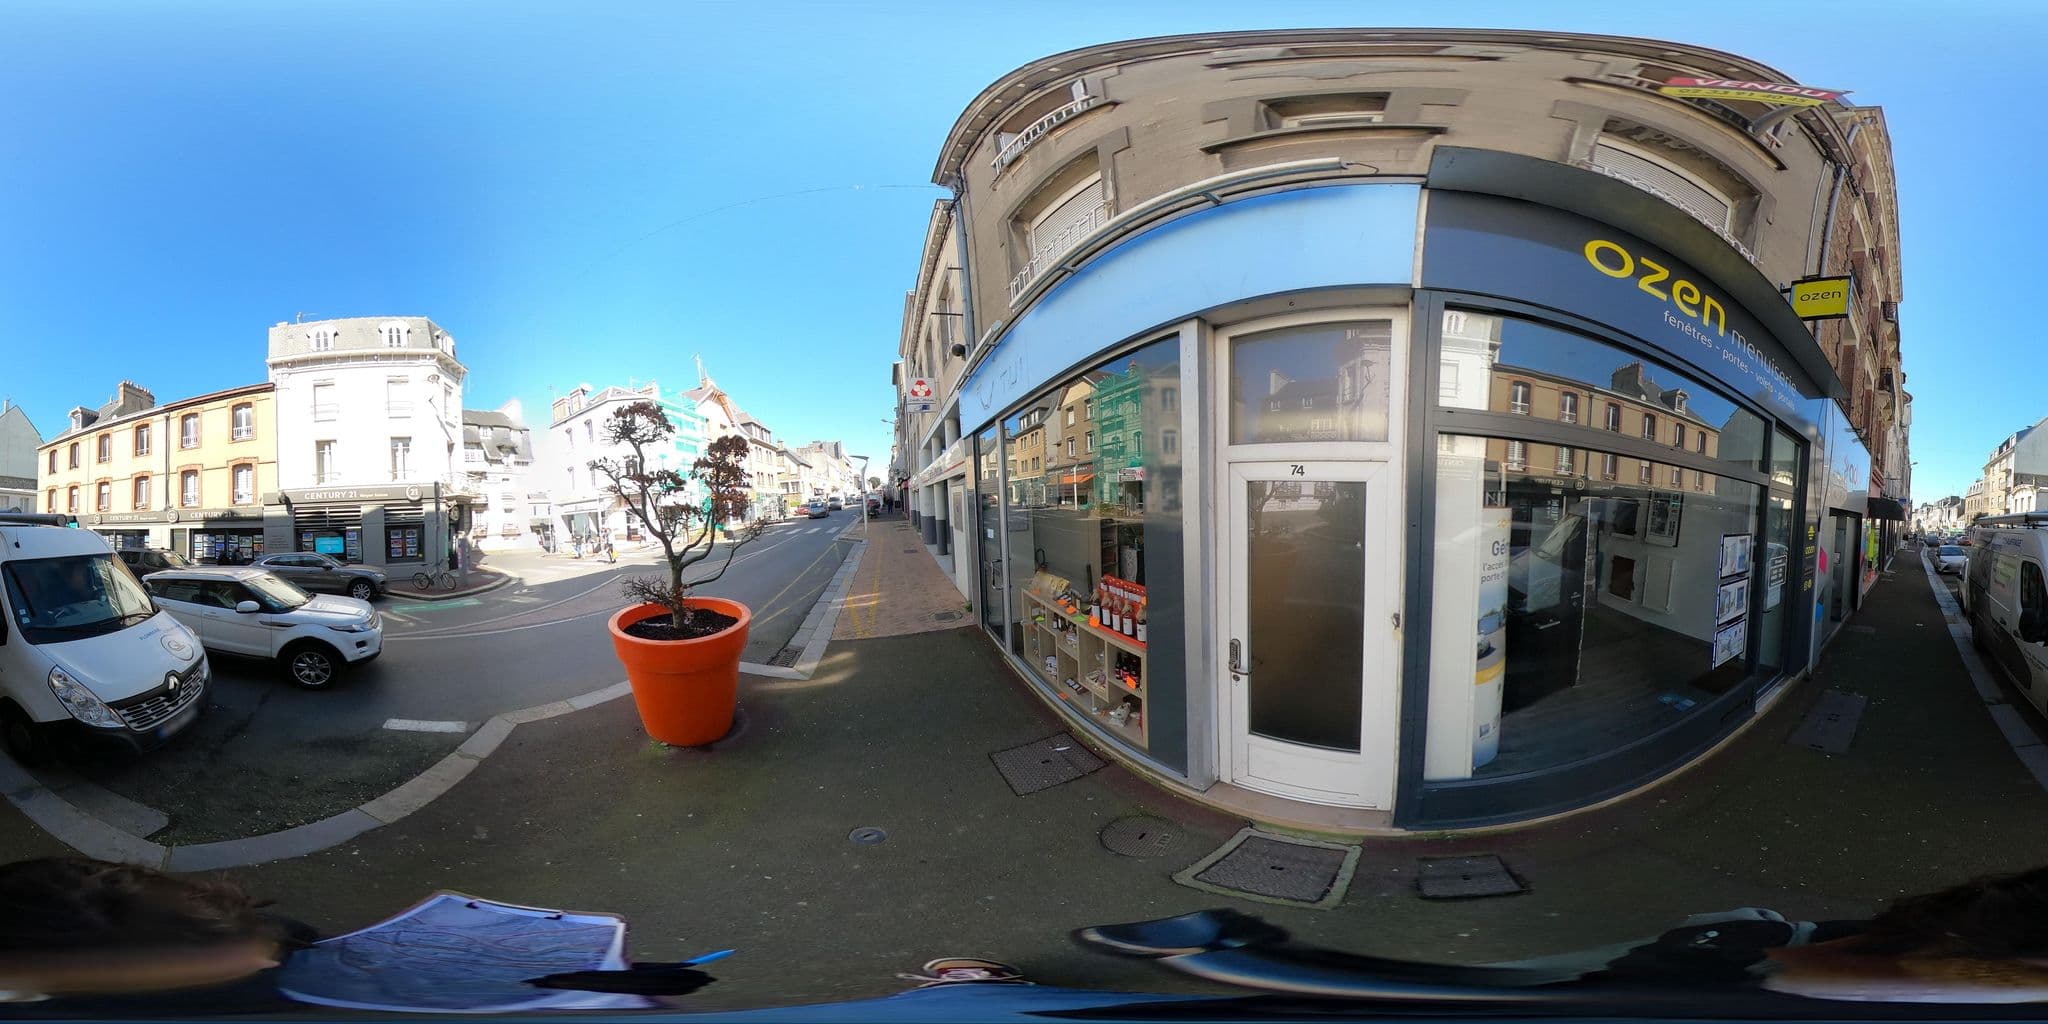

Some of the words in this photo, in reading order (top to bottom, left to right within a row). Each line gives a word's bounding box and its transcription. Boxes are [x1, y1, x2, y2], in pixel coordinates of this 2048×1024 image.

[1694, 78, 1829, 98] VENDU
[1800, 290, 1842, 301] ozen
[1584, 239, 1726, 337] ozen
[1731, 328, 1797, 393] menuiserie
[1722, 348, 1749, 374] portes
[1290, 464, 1305, 477] 74
[304, 490, 347, 500] CENTURY
[348, 490, 358, 499] 21
[190, 511, 223, 519] CENTURY
